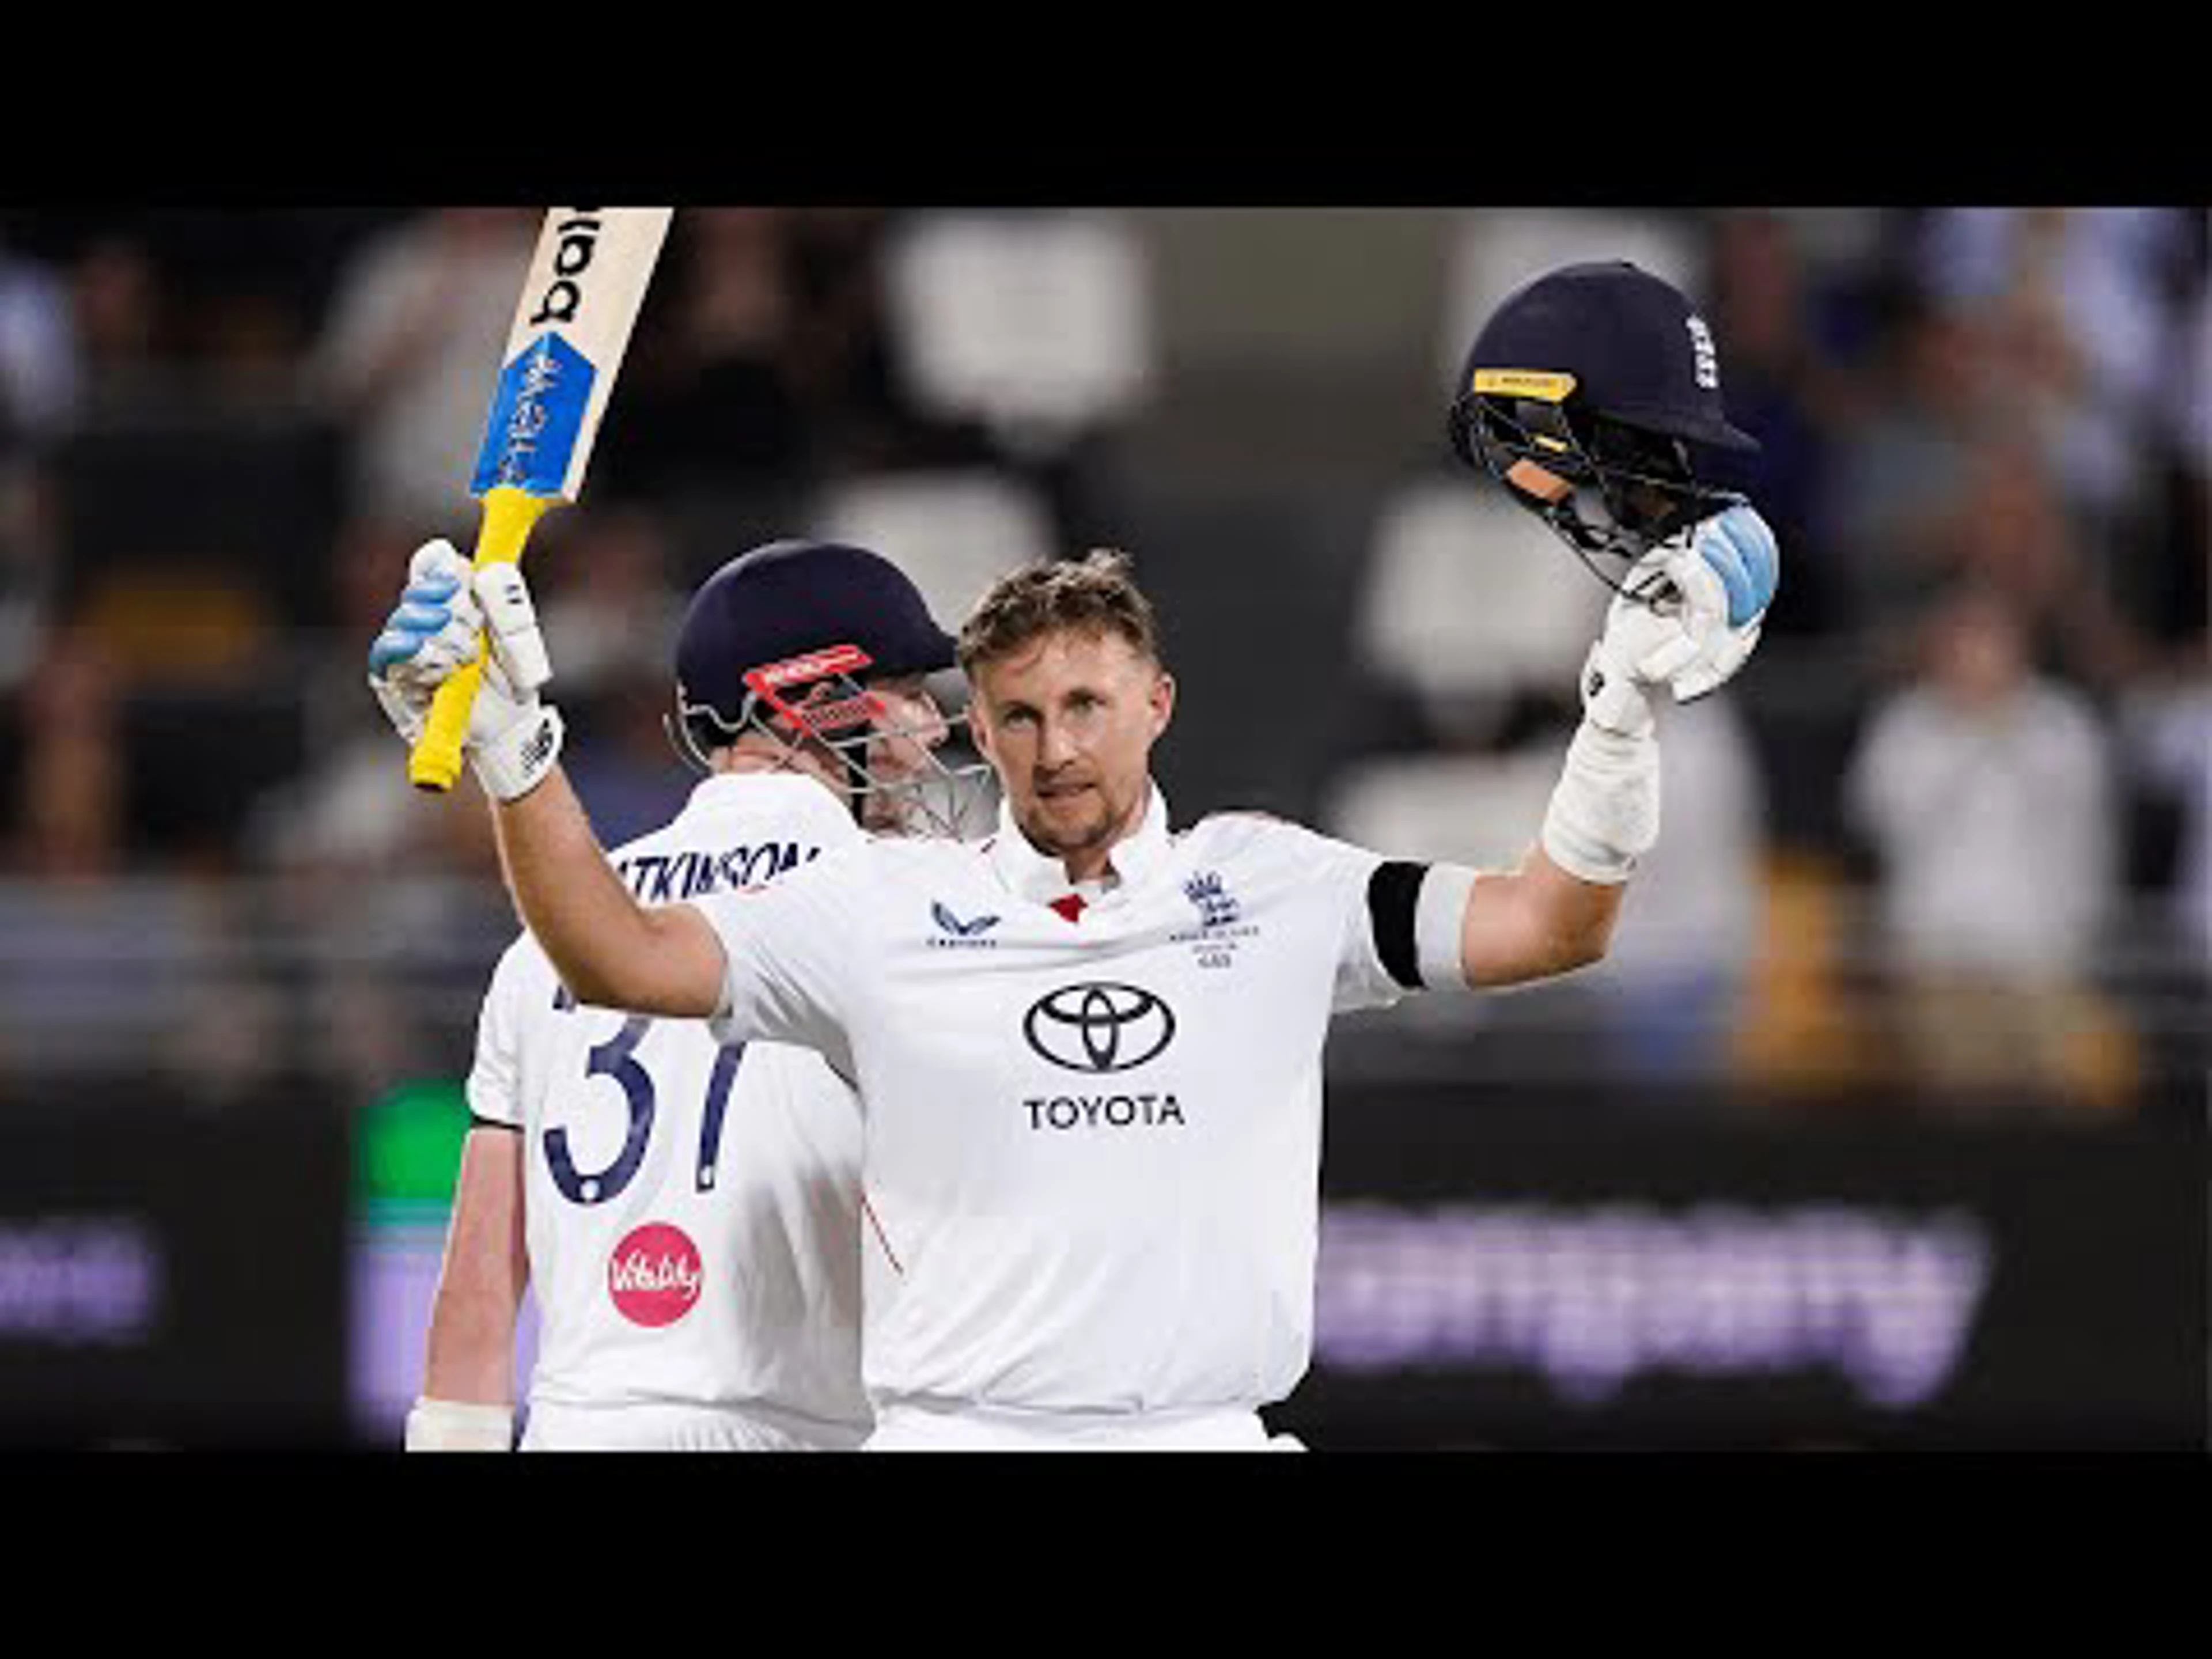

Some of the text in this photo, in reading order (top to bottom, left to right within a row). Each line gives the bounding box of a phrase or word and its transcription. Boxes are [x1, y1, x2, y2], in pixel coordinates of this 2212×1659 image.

[529, 207, 603, 325] bal
[1023, 1094, 1185, 1130] TOYOTA
[612, 1249, 700, 1301] Vitality
